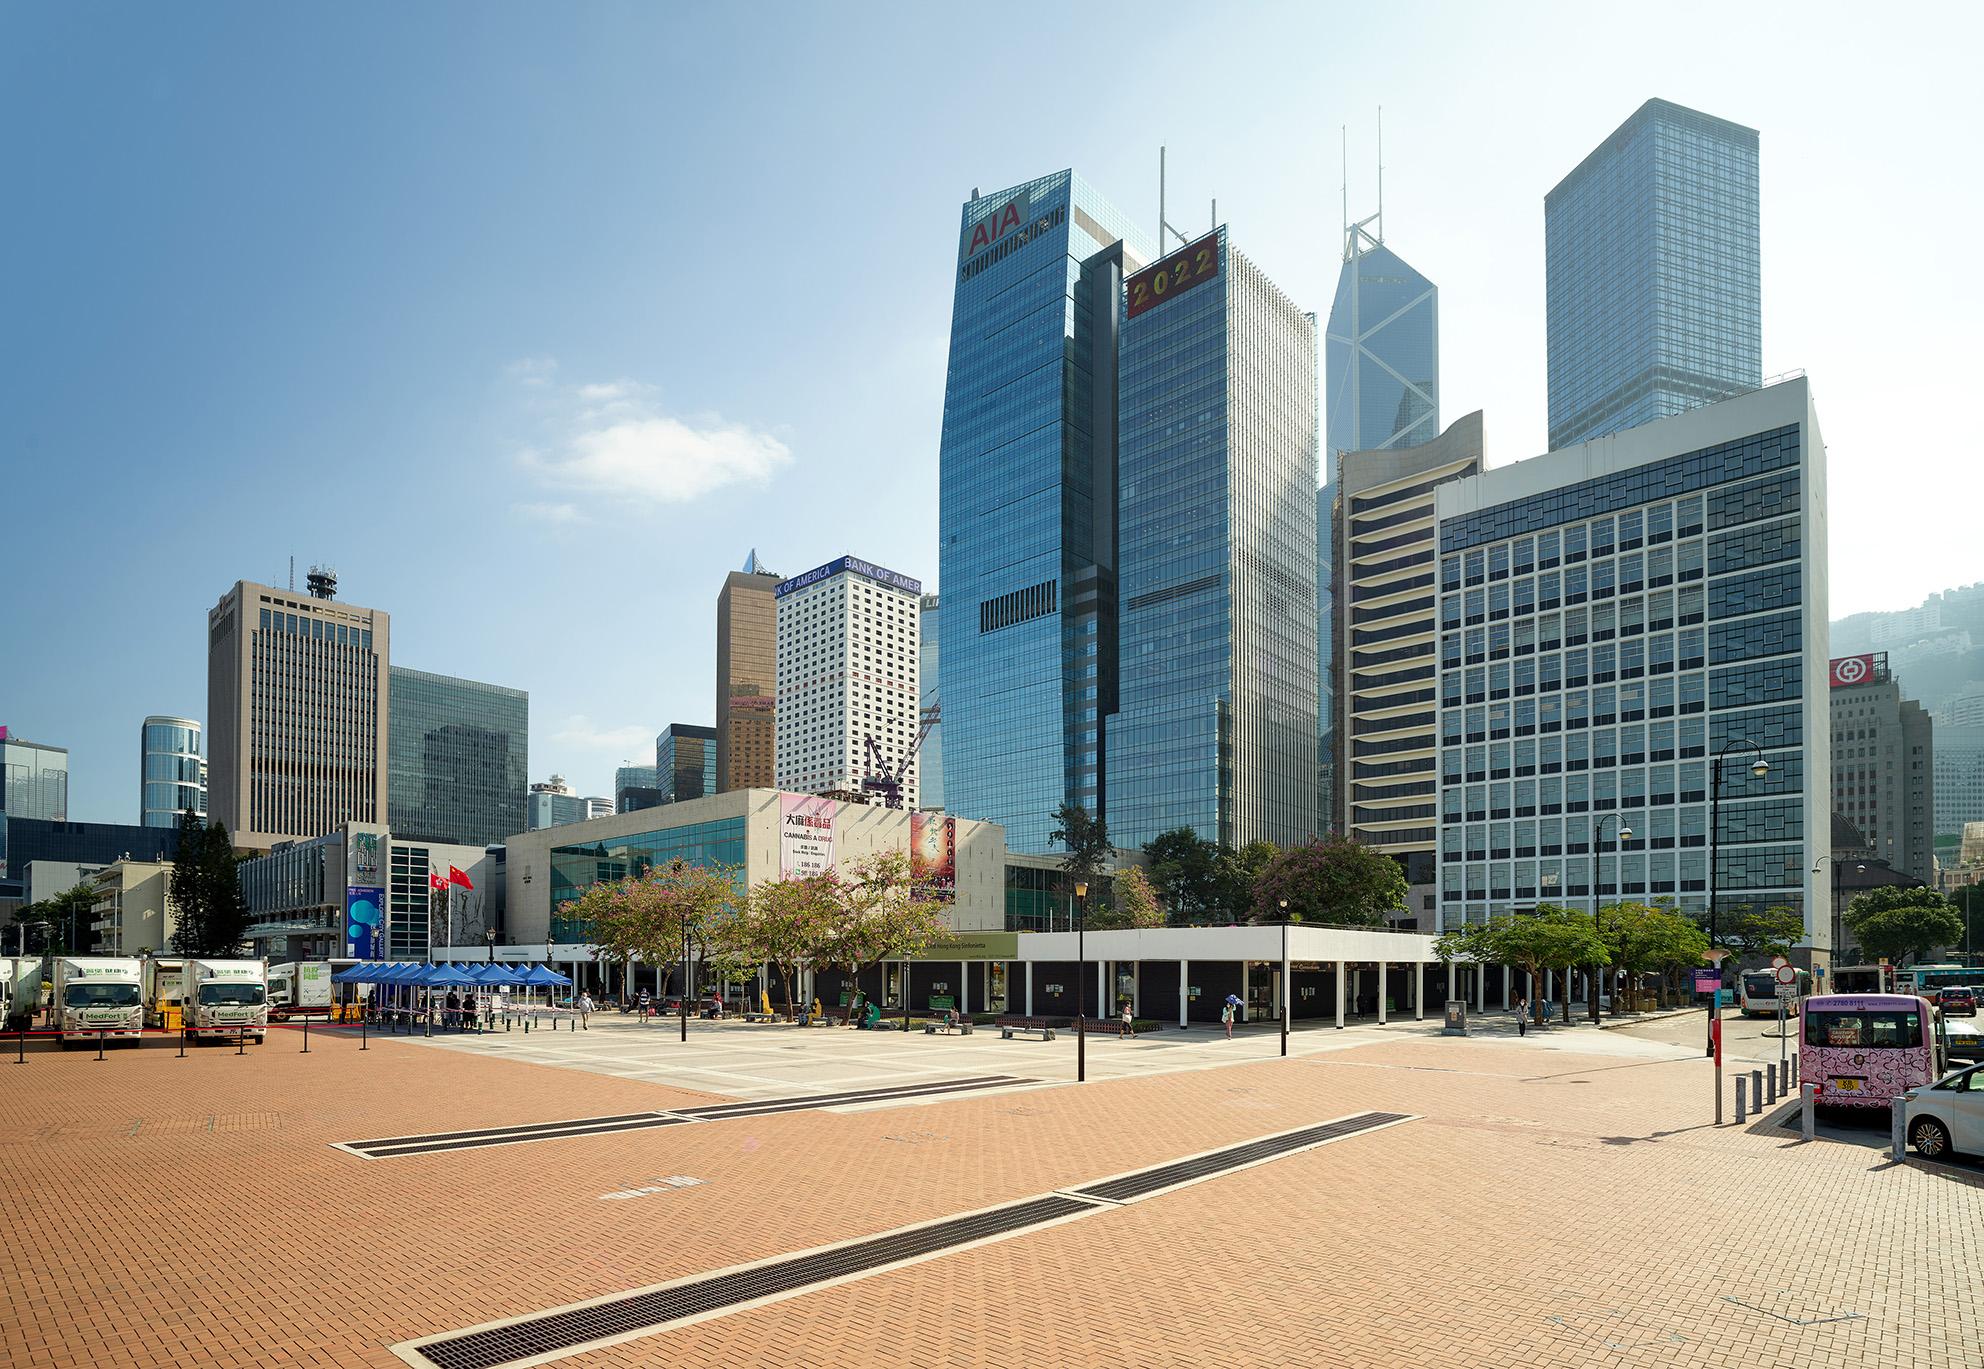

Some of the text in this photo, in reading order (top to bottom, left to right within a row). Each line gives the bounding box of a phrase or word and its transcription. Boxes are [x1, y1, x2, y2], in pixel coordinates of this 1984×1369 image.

[969, 203, 1020, 256] AIA
[1133, 249, 1213, 307] 2022
[784, 580, 794, 593] OF
[796, 565, 830, 588] AMERICA
[845, 558, 920, 592] BANK OF AMER
[784, 832, 812, 841] CANNABIS
[786, 814, 831, 830] 大麻係毒品
